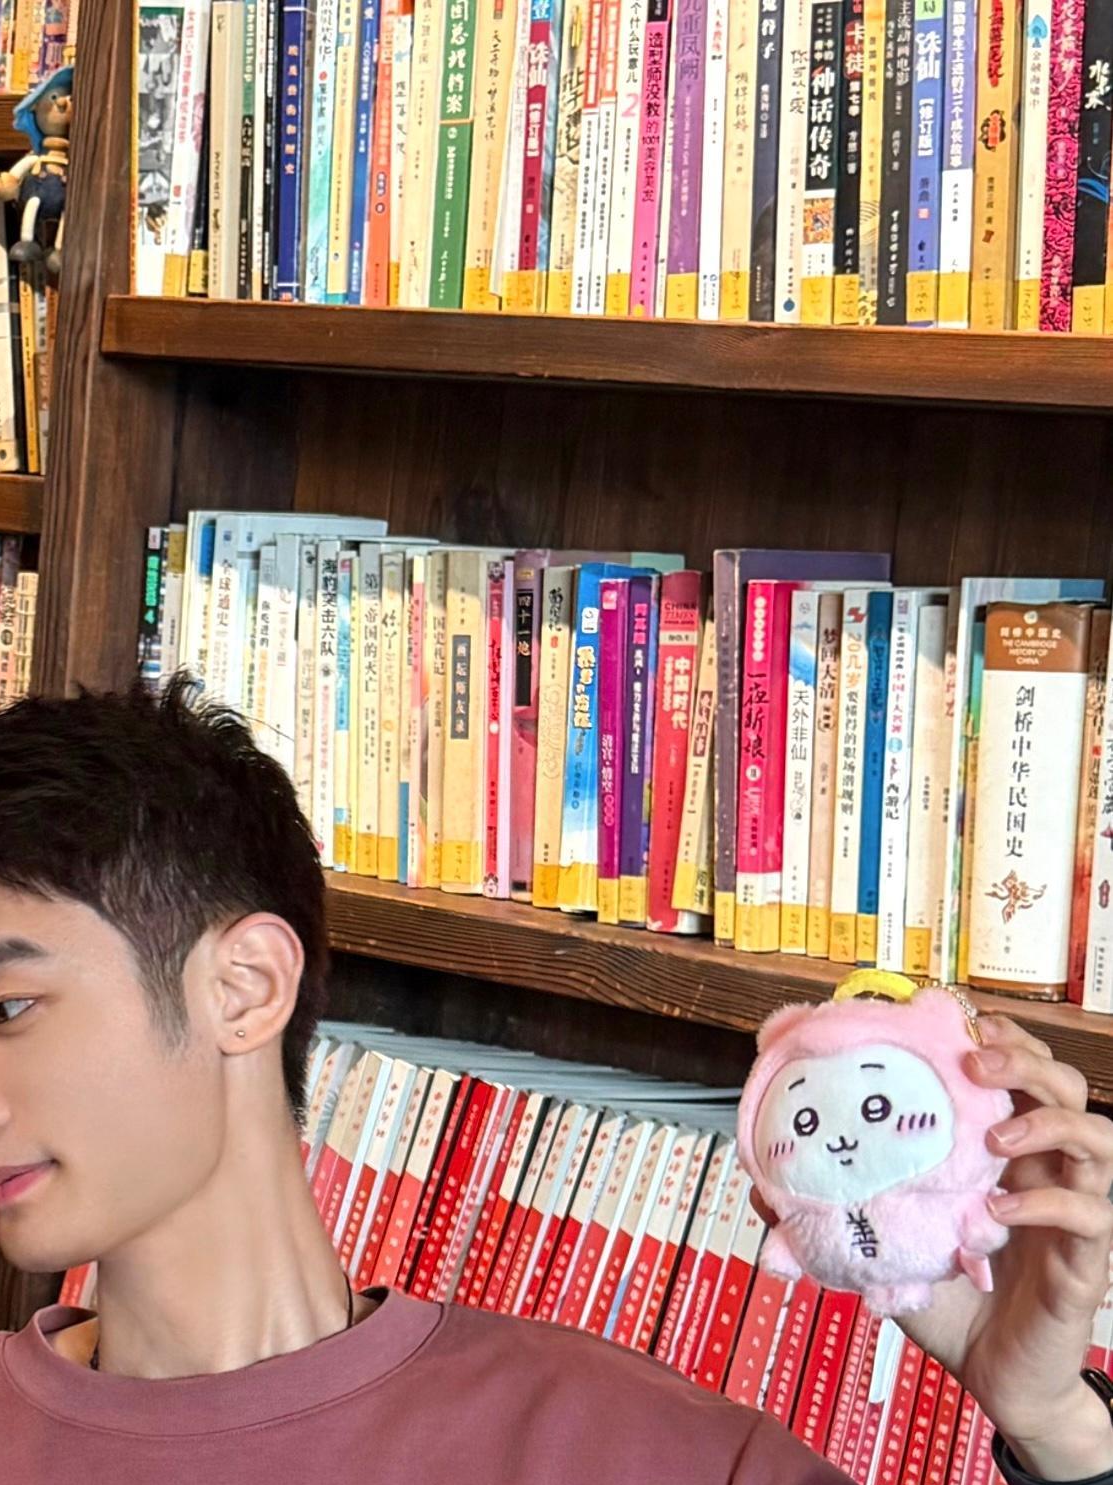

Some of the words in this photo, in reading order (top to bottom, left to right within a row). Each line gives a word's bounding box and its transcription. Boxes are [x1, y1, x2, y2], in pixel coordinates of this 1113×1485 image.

[527, 41, 550, 88] 诛仙
[916, 30, 942, 81] 诛仙
[810, 68, 836, 181] 神话传奇
[320, 558, 339, 657] 海豹突击六队
[743, 672, 770, 760] 一夜新娘
[1004, 684, 1036, 859] 剑桥中华民国史
